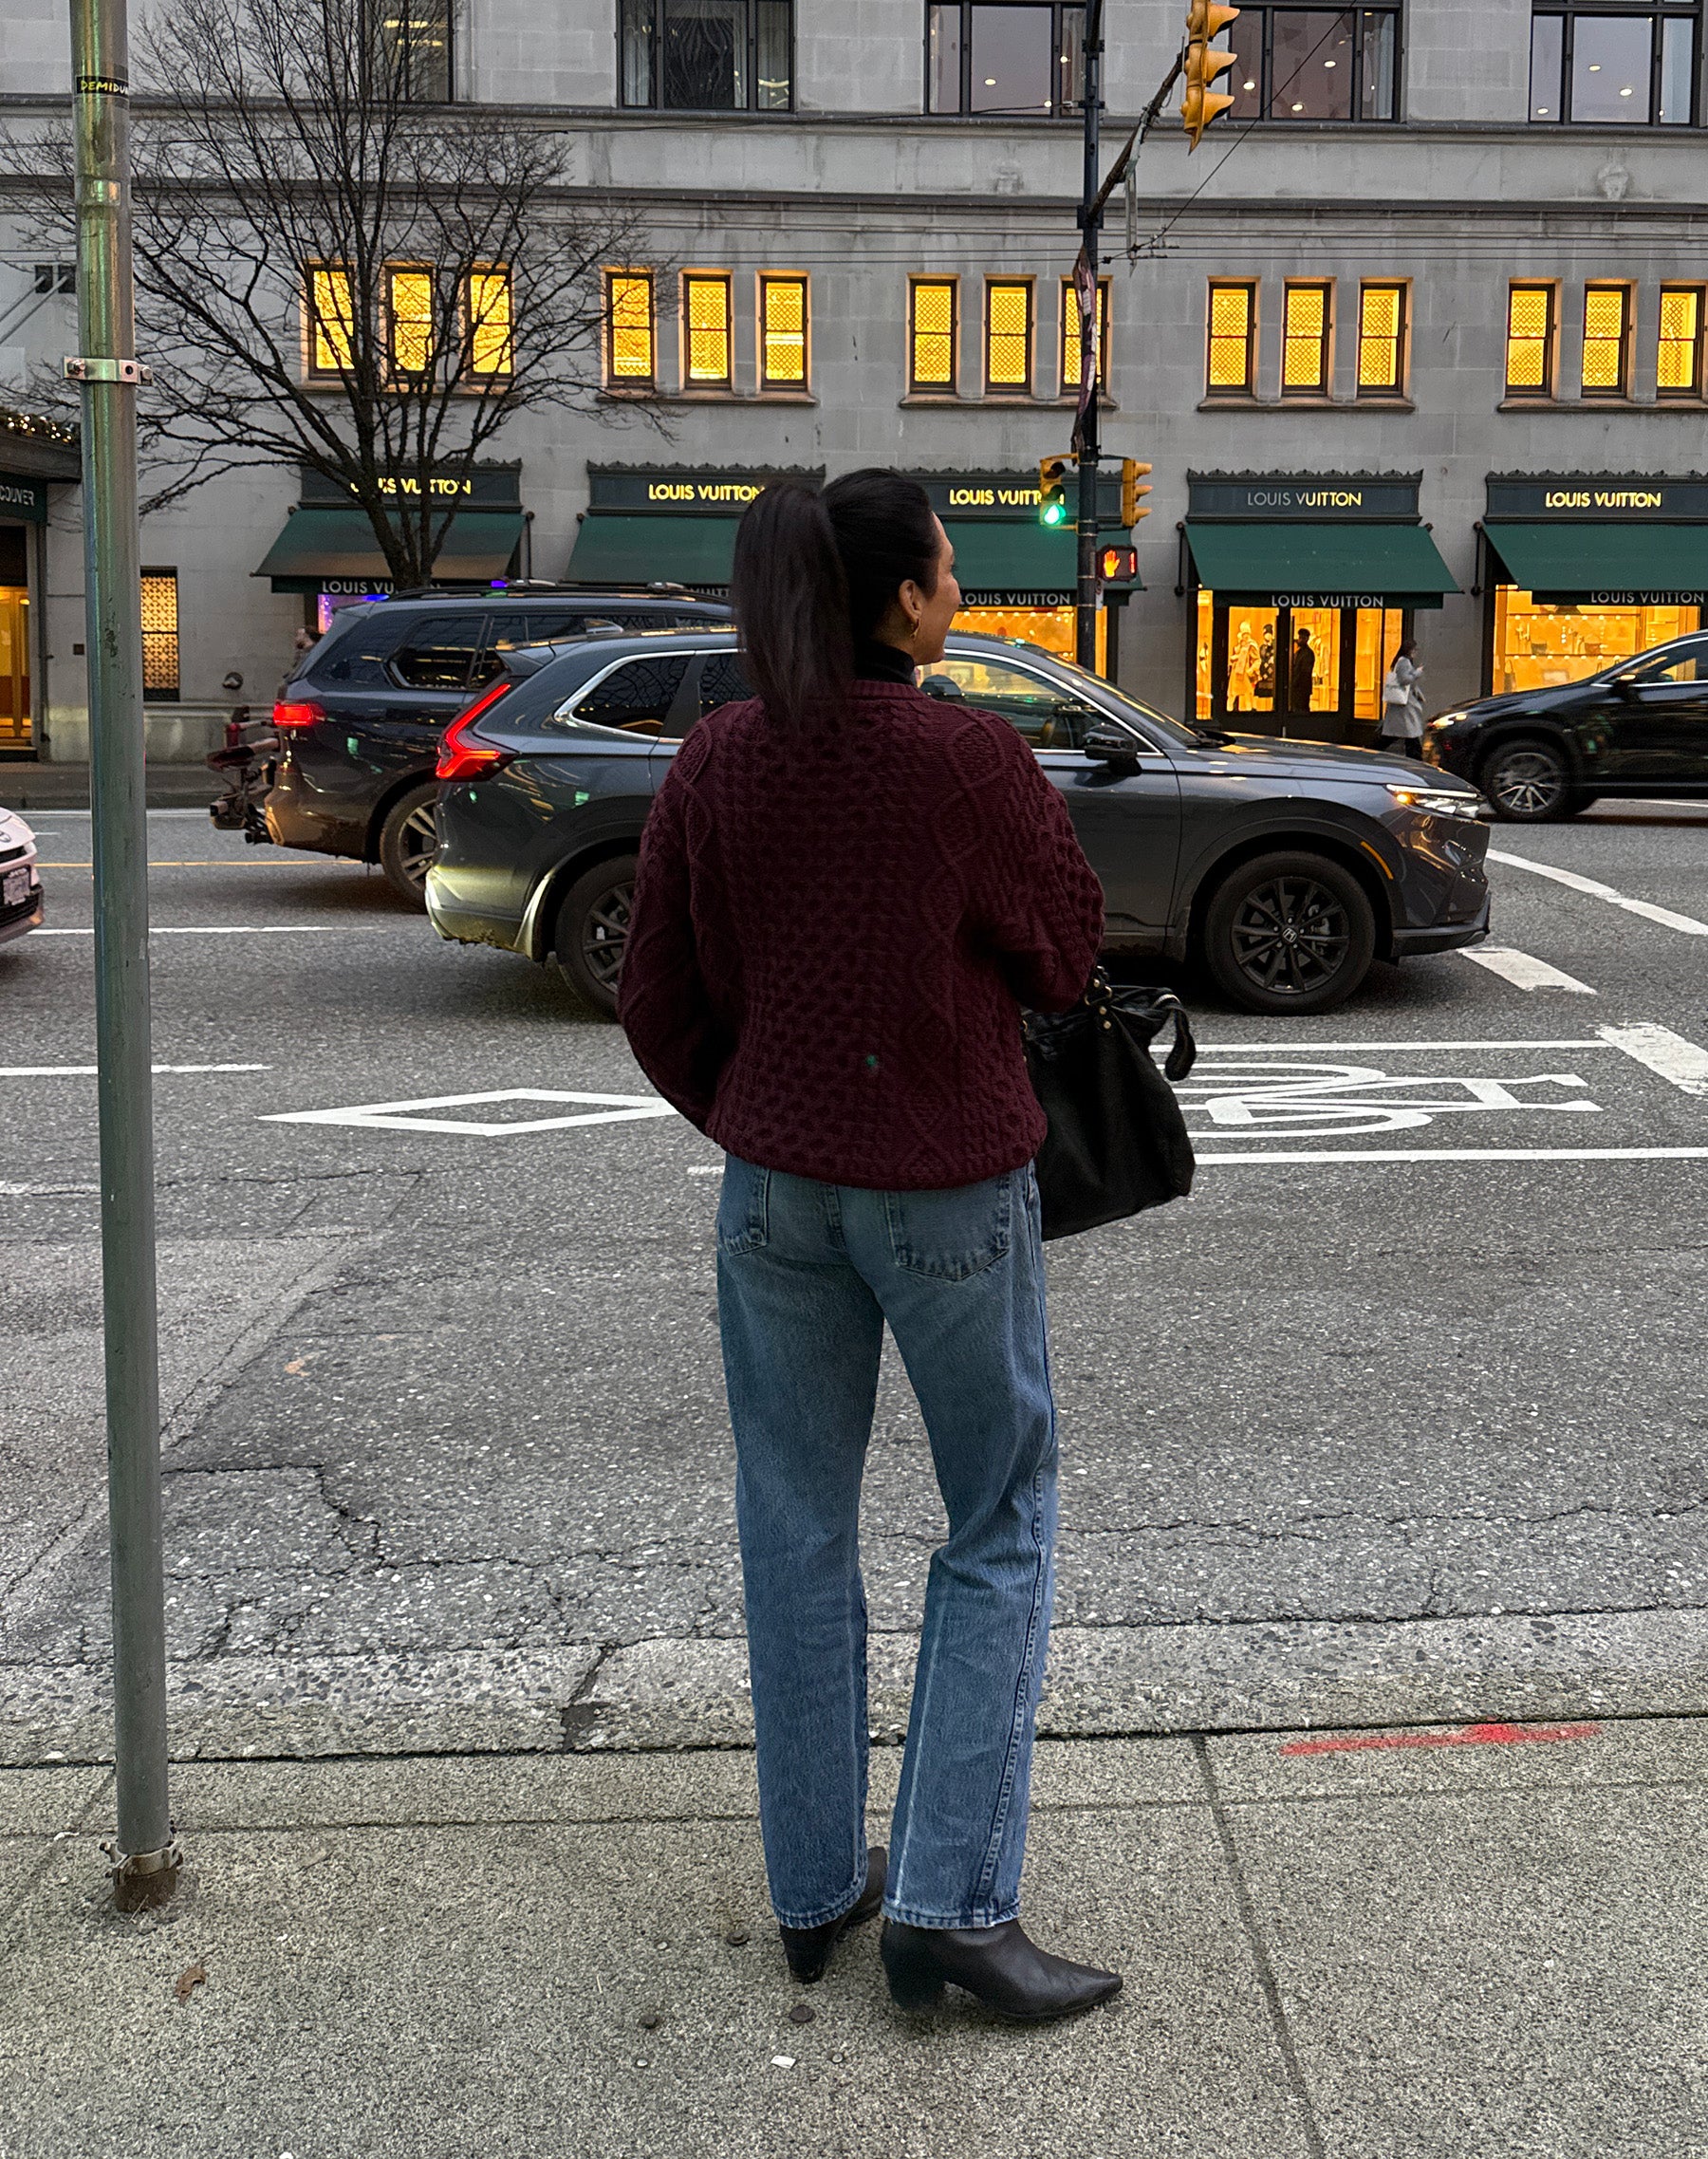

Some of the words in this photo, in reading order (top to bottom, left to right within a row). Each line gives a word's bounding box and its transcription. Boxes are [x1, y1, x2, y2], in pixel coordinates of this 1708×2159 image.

[400, 478, 472, 494] VUTTON
[649, 484, 695, 500] LOUIS
[950, 489, 994, 505] LOUIS
[997, 490, 1065, 505] VUITT
[1247, 492, 1291, 506] LOUIS
[1296, 492, 1362, 507] VUITTON
[1545, 492, 1590, 508] LOUIS
[1594, 492, 1662, 508] VUITTON
[323, 580, 368, 594] LOUIS
[1006, 593, 1070, 605] VUITTON
[1272, 594, 1315, 607] LOUIS
[1320, 595, 1383, 608] VUITTON
[1590, 591, 1635, 605] LOUIS
[1640, 591, 1705, 605] VUITTON
